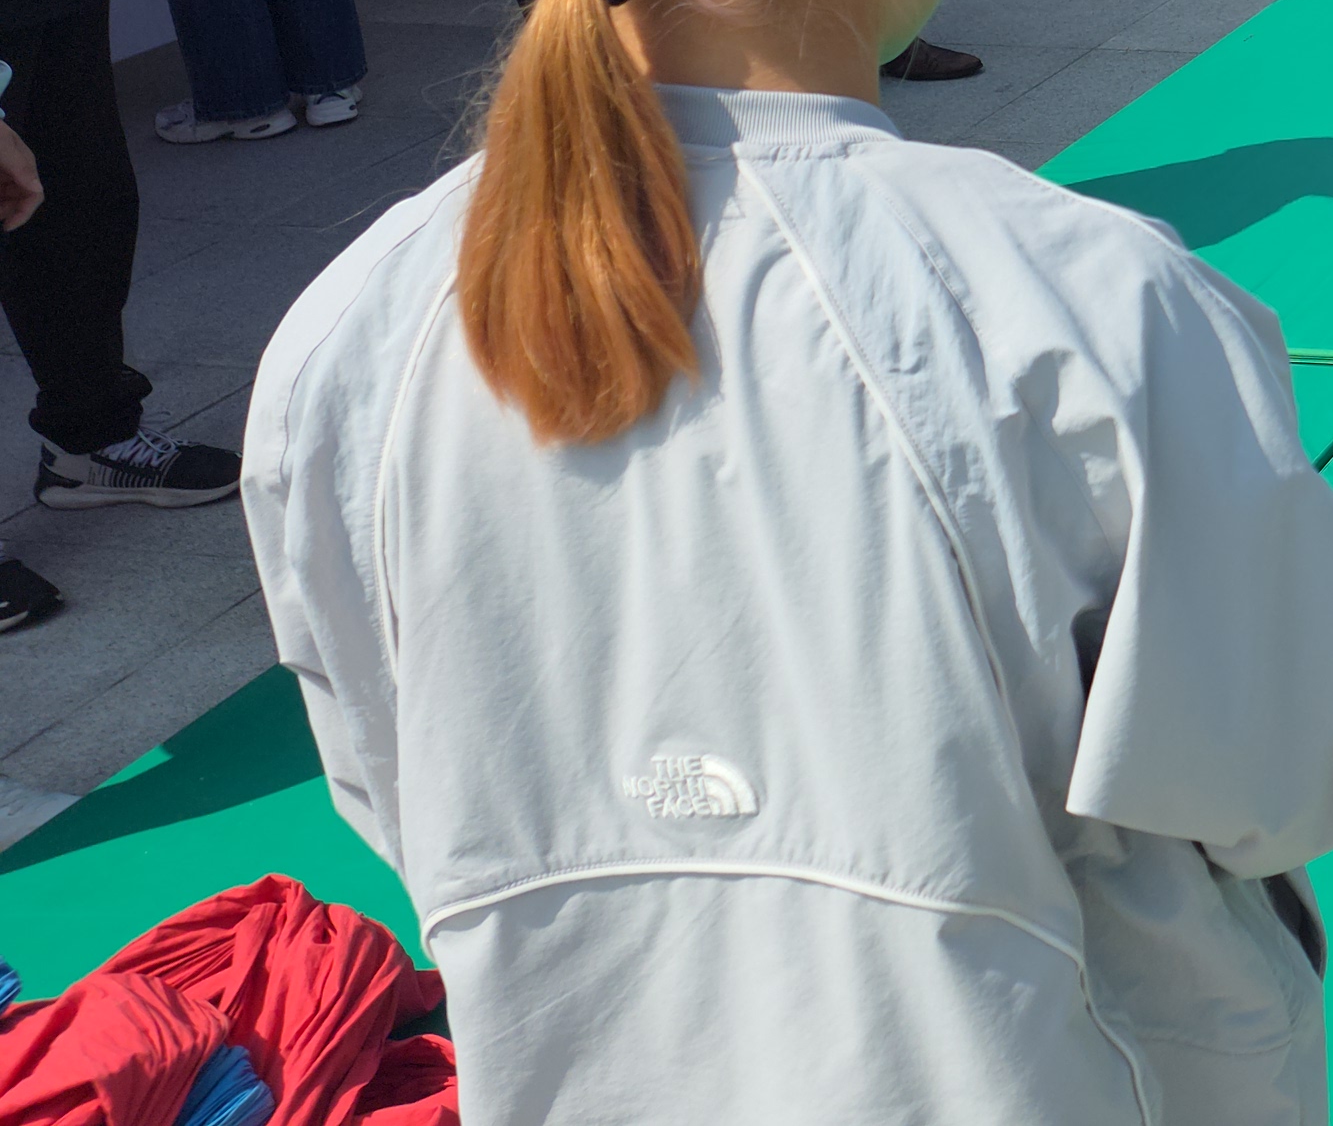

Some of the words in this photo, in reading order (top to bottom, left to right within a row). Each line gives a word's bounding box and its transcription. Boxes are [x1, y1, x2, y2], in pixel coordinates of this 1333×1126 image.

[651, 755, 703, 777] THE
[622, 775, 707, 798] NORTH
[645, 796, 711, 819] FACE
